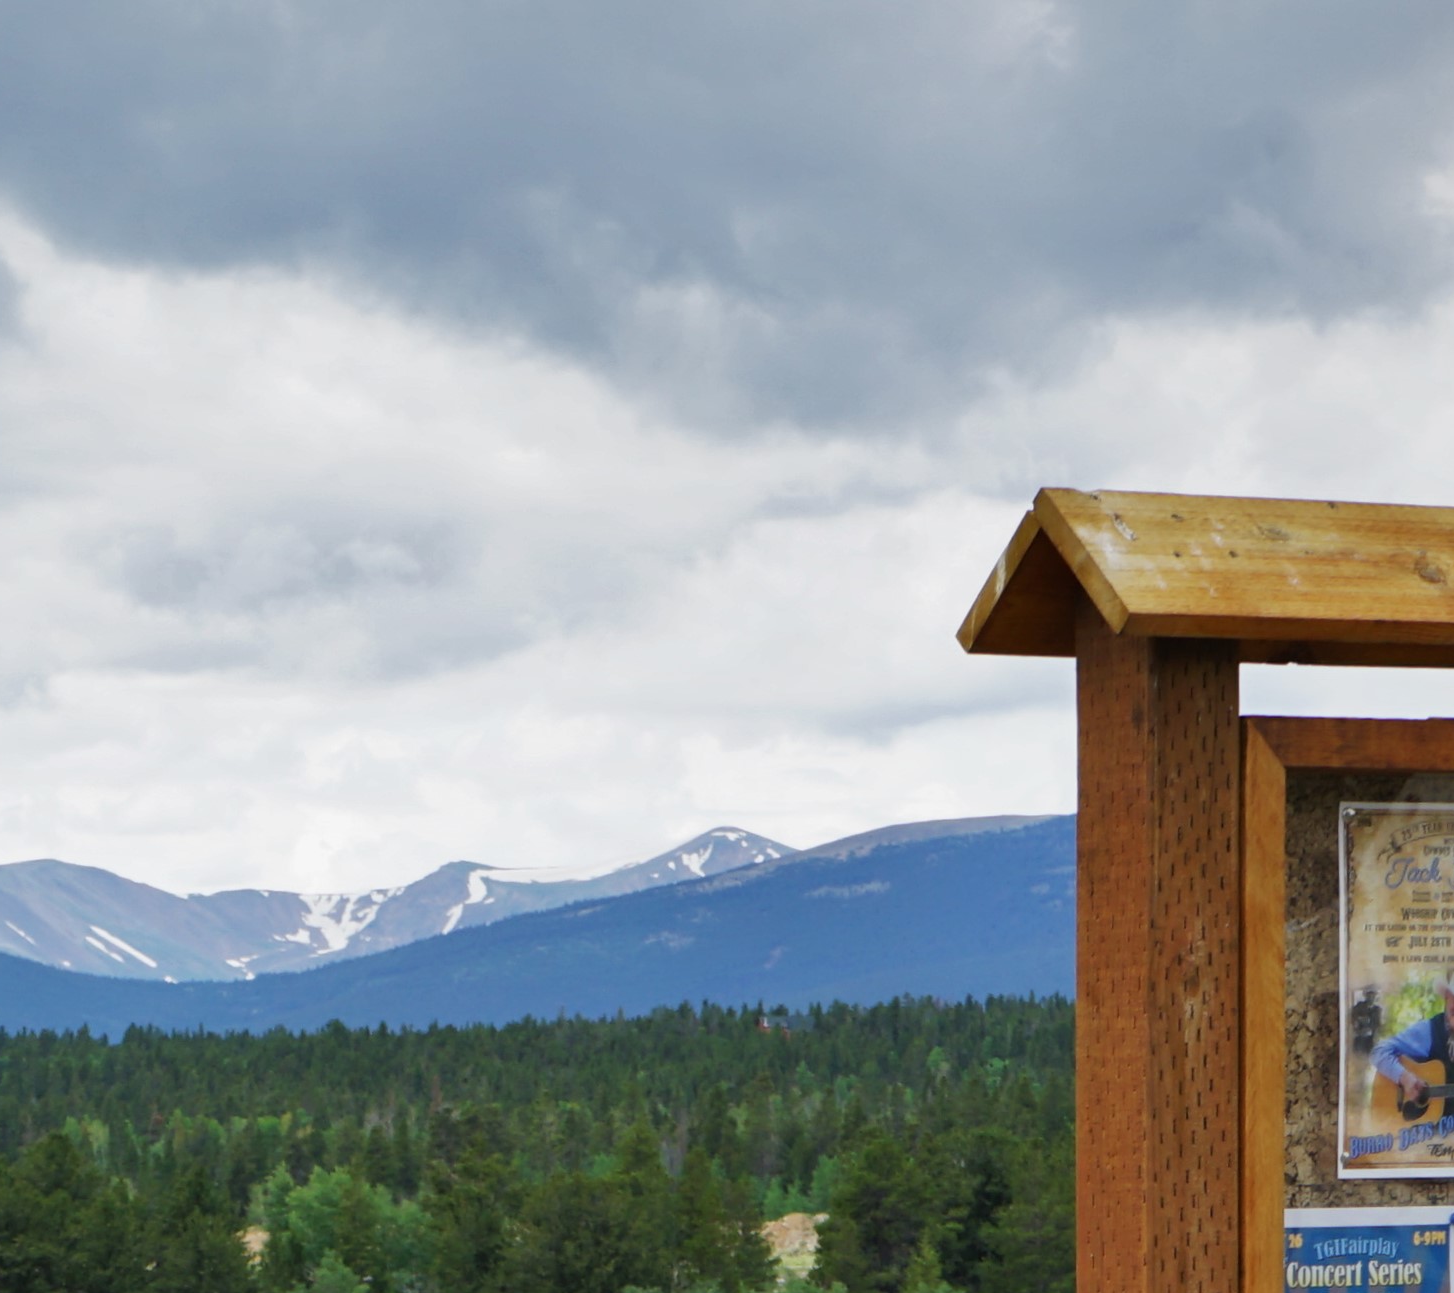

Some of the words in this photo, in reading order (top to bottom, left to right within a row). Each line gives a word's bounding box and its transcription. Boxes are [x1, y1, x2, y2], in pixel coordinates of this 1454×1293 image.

[1385, 857, 1441, 889] Jack
[1349, 1134, 1394, 1159] BURRO
[1398, 1121, 1434, 1150] DAYS
[1313, 1236, 1400, 1261] TGIFairplay
[1413, 1231, 1446, 1246] 6-9PM
[1286, 1261, 1362, 1288] Concert
[1368, 1259, 1422, 1286] Series
